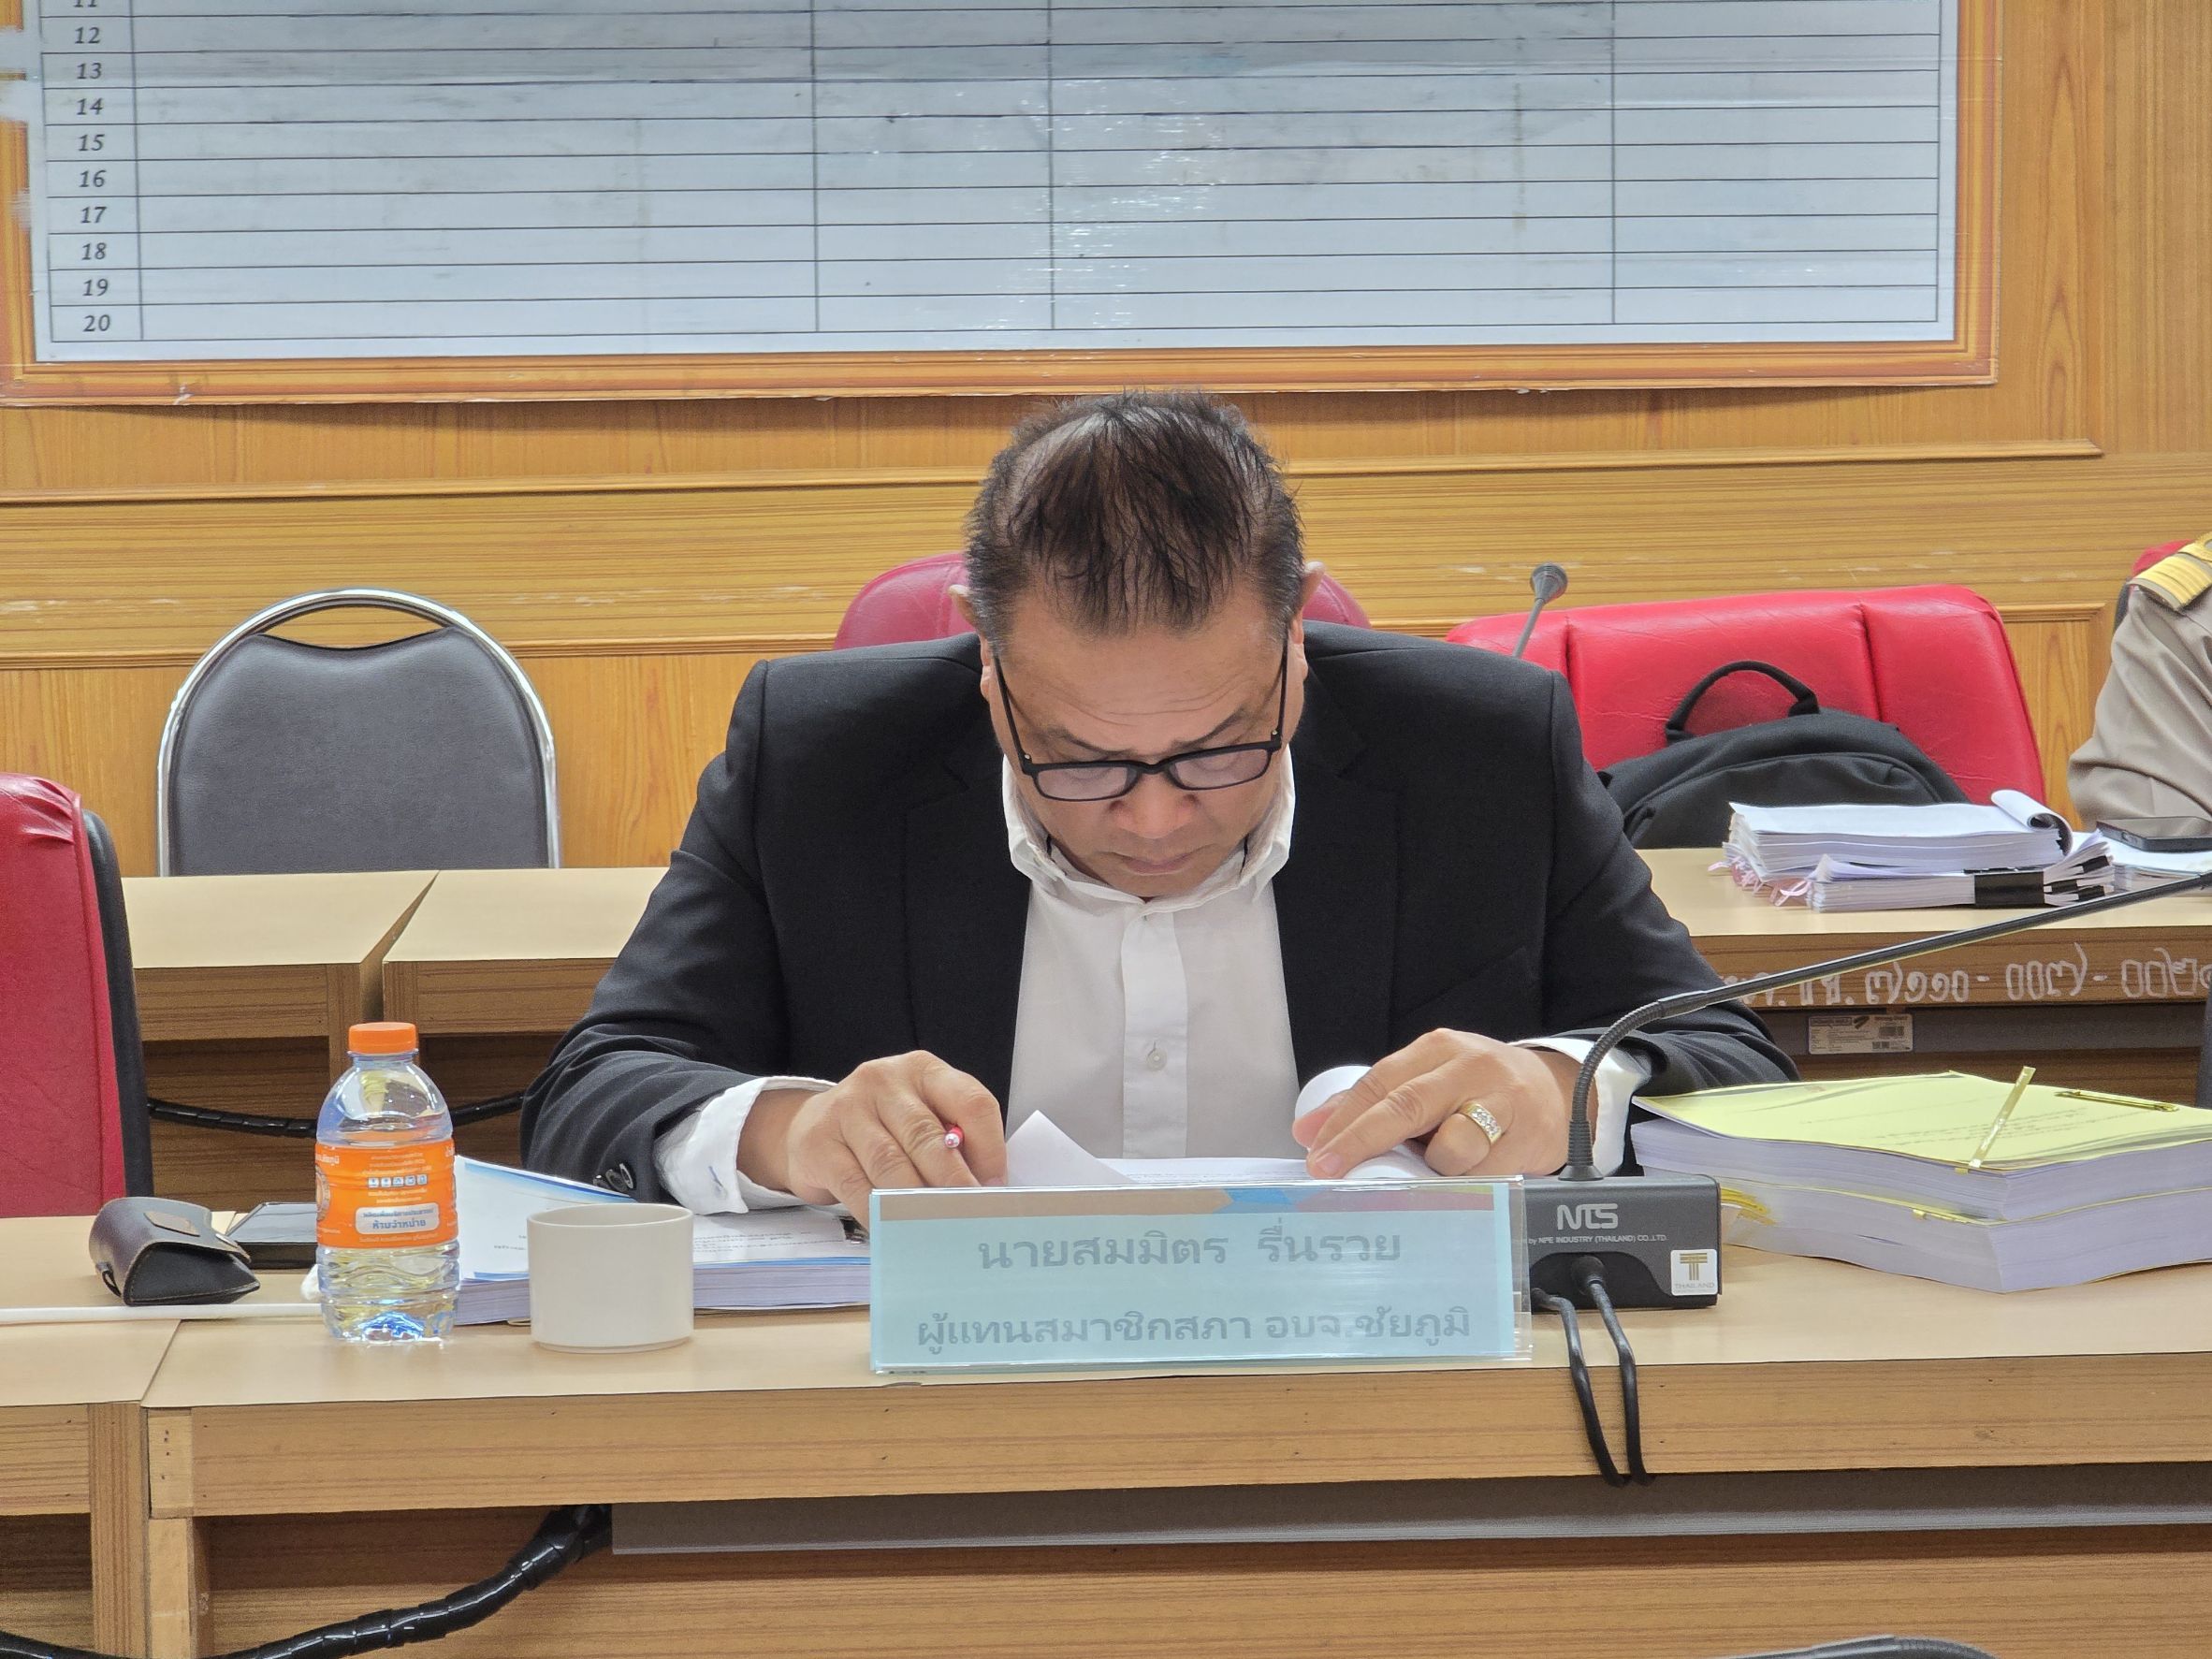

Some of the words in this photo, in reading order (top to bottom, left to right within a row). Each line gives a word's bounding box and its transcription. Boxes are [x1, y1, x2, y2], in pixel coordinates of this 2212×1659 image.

[75, 26, 101, 45] 12
[76, 63, 102, 80] 13
[76, 98, 104, 115] 14
[78, 134, 105, 152] 15
[79, 169, 106, 188] 16
[80, 206, 107, 224] 17
[81, 242, 107, 261] 18
[82, 278, 109, 297] 19
[83, 314, 110, 332] 20
[978, 1230, 1229, 1270] นายสมมิตร
[1258, 1217, 1402, 1262] รื่นรวย
[1594, 1234, 1637, 1243] (THAILAND)
[917, 1311, 1252, 1355] ผู้แทนสมาชิกสภา
[1265, 1306, 1471, 1347] อบจ.ชัยภูมิ
